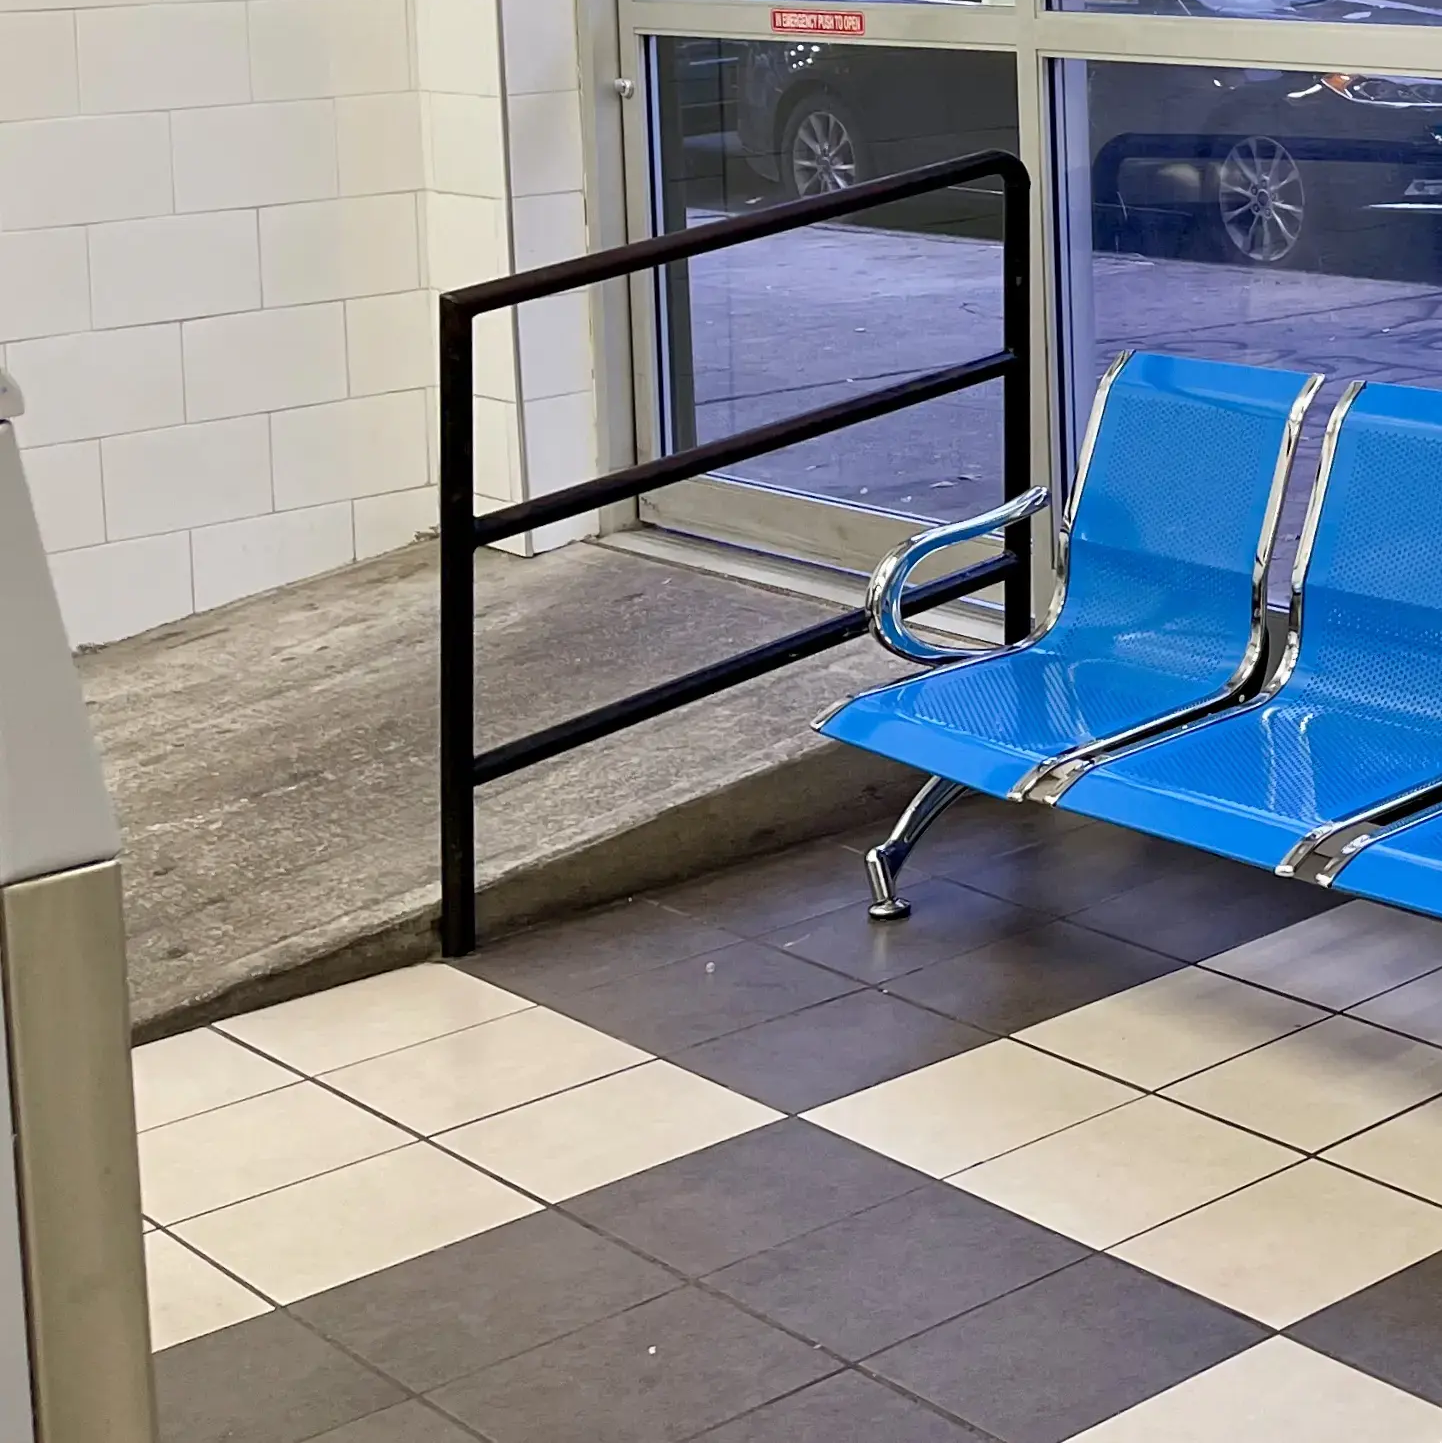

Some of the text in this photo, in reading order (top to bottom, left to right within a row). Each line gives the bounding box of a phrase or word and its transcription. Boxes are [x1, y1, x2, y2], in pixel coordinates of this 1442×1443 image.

[782, 13, 818, 29] EMERGENCY
[818, 14, 835, 29] PUSH
[835, 15, 843, 30] TO
[843, 15, 861, 31] OPEN
